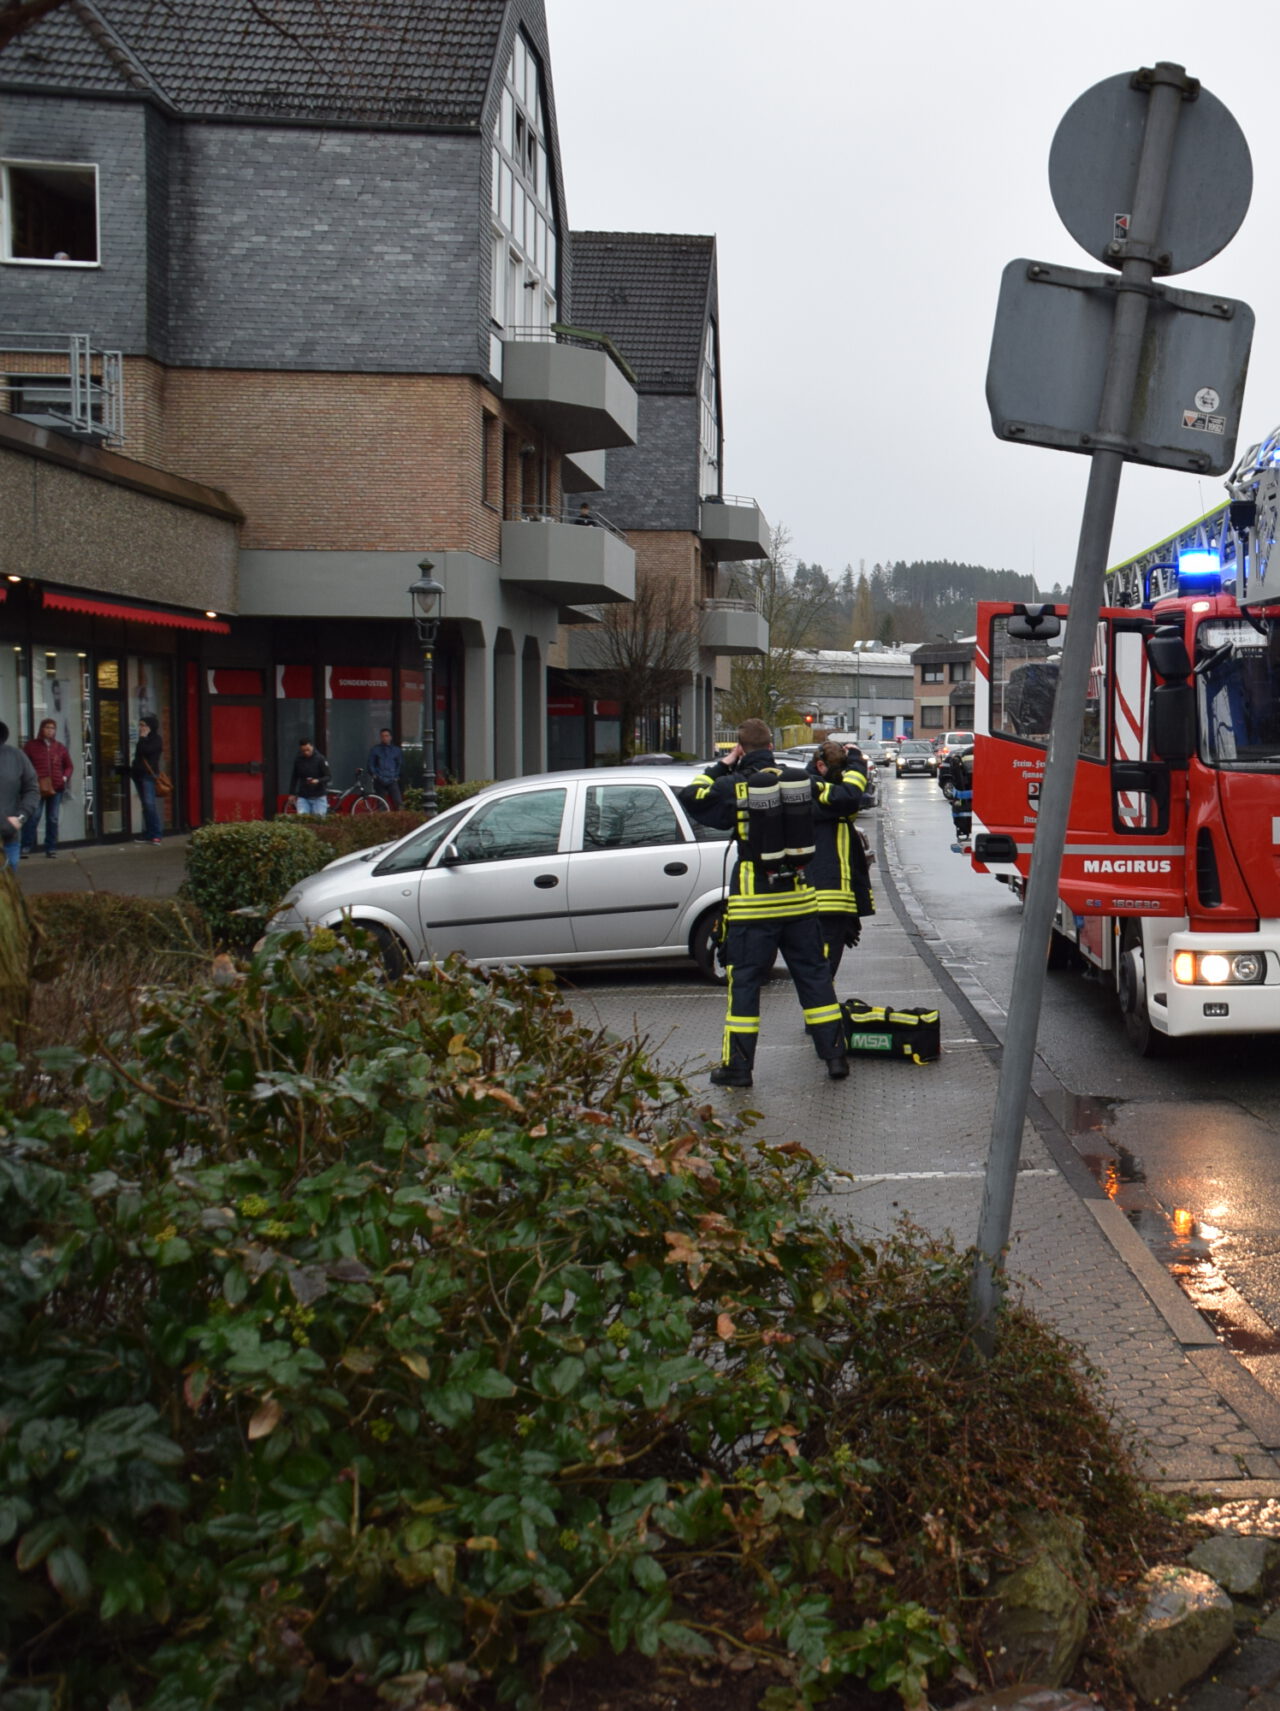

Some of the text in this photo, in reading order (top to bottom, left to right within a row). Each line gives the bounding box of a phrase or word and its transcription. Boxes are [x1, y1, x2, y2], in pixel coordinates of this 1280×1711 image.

[338, 679, 388, 687] SONDERPOSTEN
[1083, 860, 1172, 873] MAGIRUS
[853, 1035, 889, 1048] MSA
